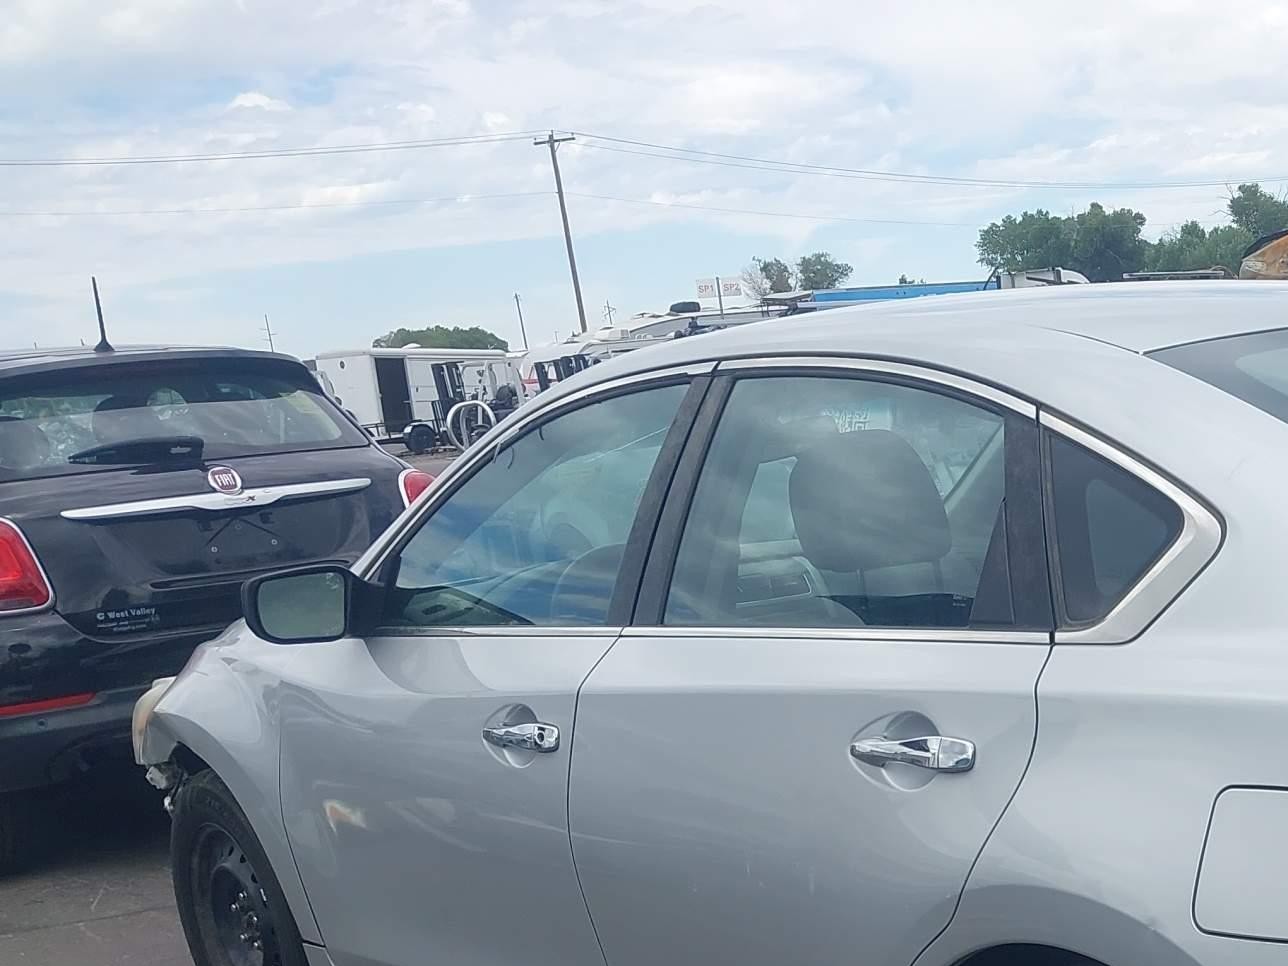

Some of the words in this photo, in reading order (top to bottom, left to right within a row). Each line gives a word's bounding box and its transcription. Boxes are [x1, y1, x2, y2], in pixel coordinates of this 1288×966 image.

[699, 285, 714, 293] SP1
[723, 283, 741, 291] SP2
[214, 473, 235, 487] FIAT
[106, 609, 129, 619] West
[129, 606, 156, 616] Valley
